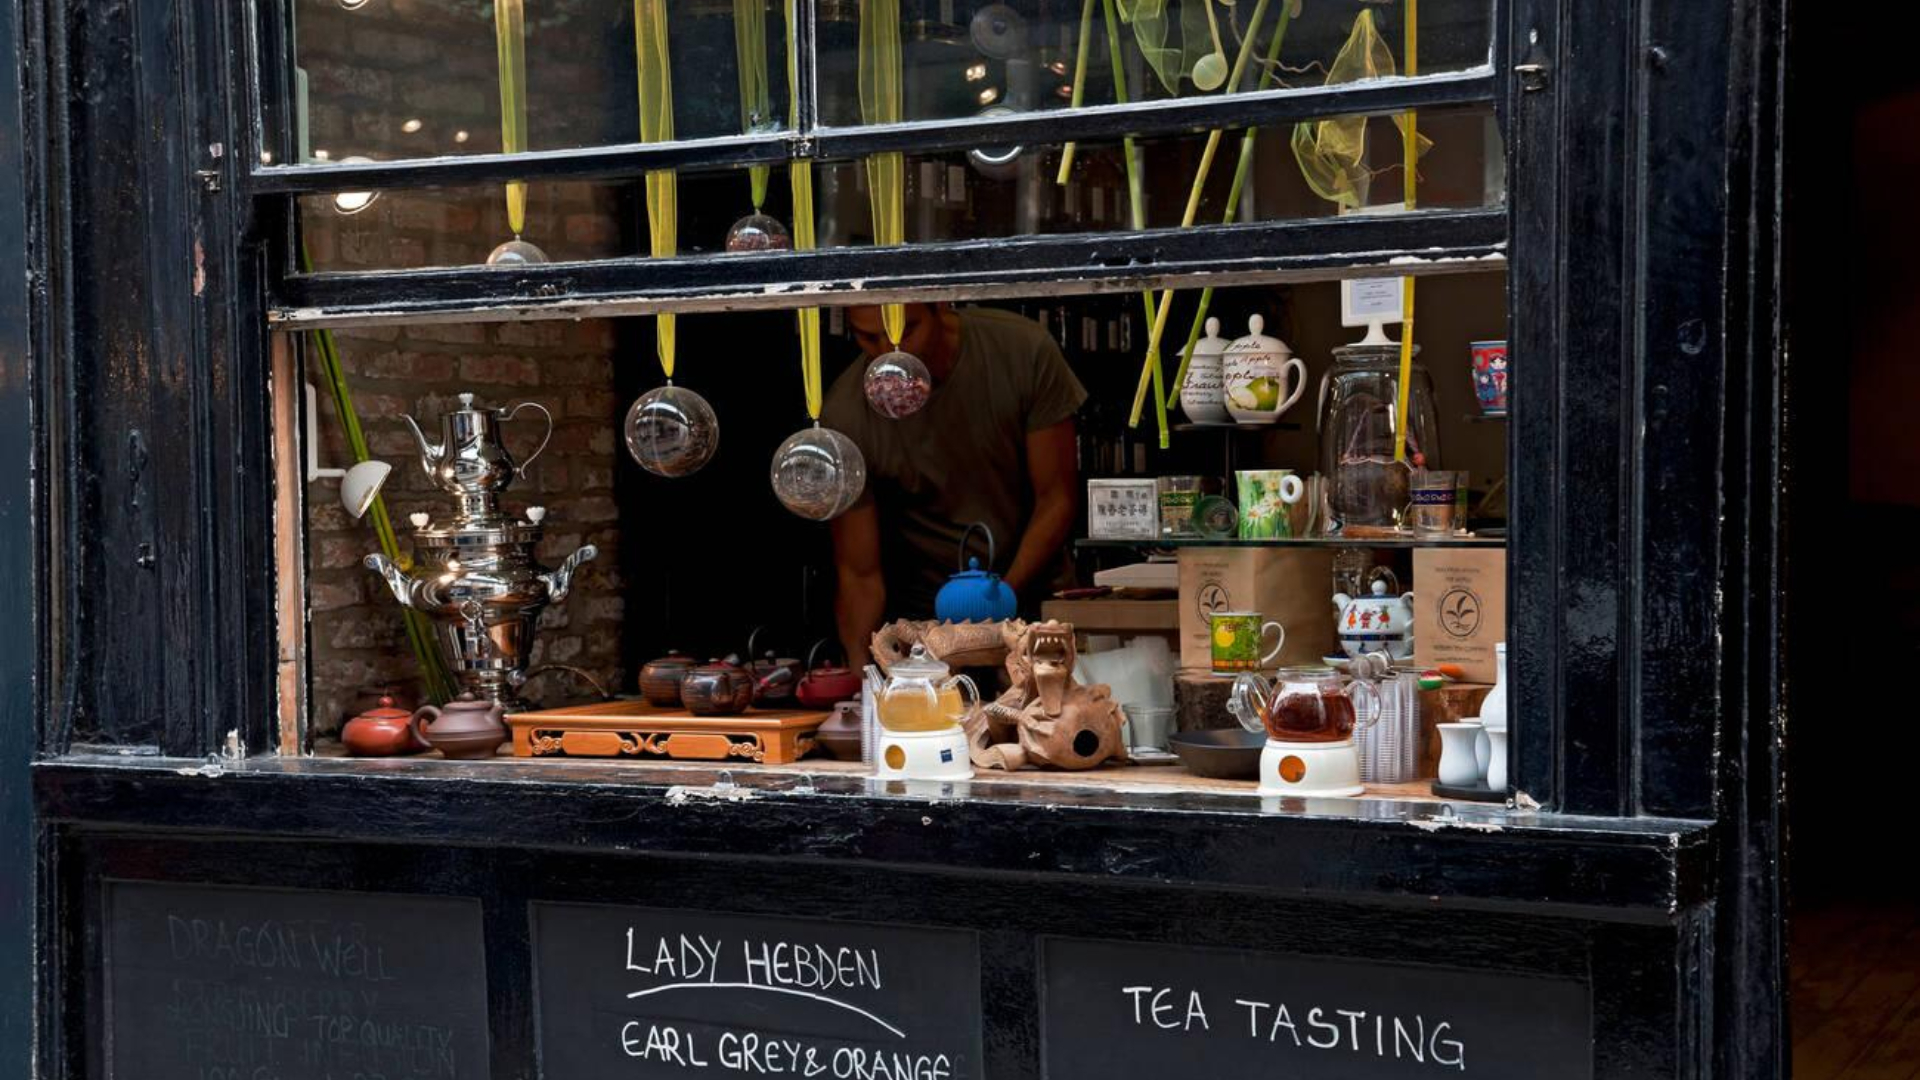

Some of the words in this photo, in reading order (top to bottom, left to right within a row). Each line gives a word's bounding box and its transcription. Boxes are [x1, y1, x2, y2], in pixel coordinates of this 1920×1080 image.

[167, 914, 302, 968] DRAGON
[310, 928, 399, 982] WELL
[626, 927, 721, 984] LADY
[744, 940, 881, 990] HEBDEN
[307, 1014, 354, 1043] TOP
[622, 1022, 708, 1067] EARL
[833, 1047, 951, 1080] ORANGE
[1122, 986, 1210, 1031] TEA
[1235, 999, 1465, 1071] TASTING
